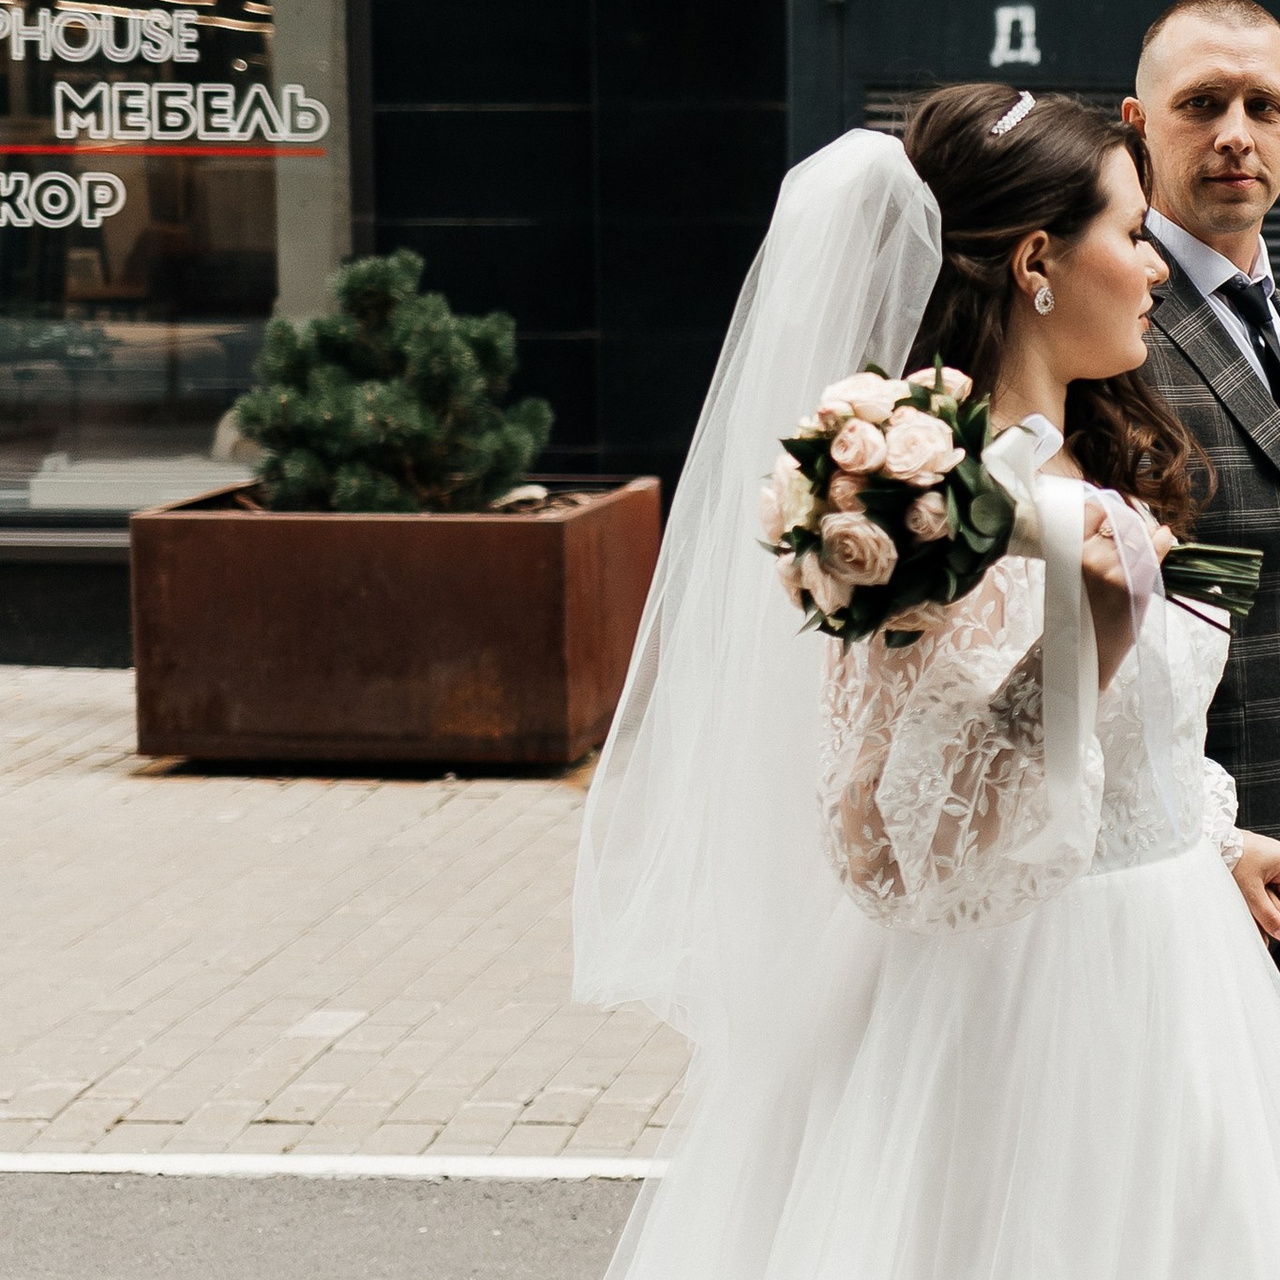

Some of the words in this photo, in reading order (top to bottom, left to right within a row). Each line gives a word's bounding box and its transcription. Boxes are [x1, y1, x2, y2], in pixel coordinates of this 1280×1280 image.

[0, 7, 199, 62] HOUSE
[990, 4, 1041, 67] Д
[55, 81, 330, 142] МЕБЕЛЬ
